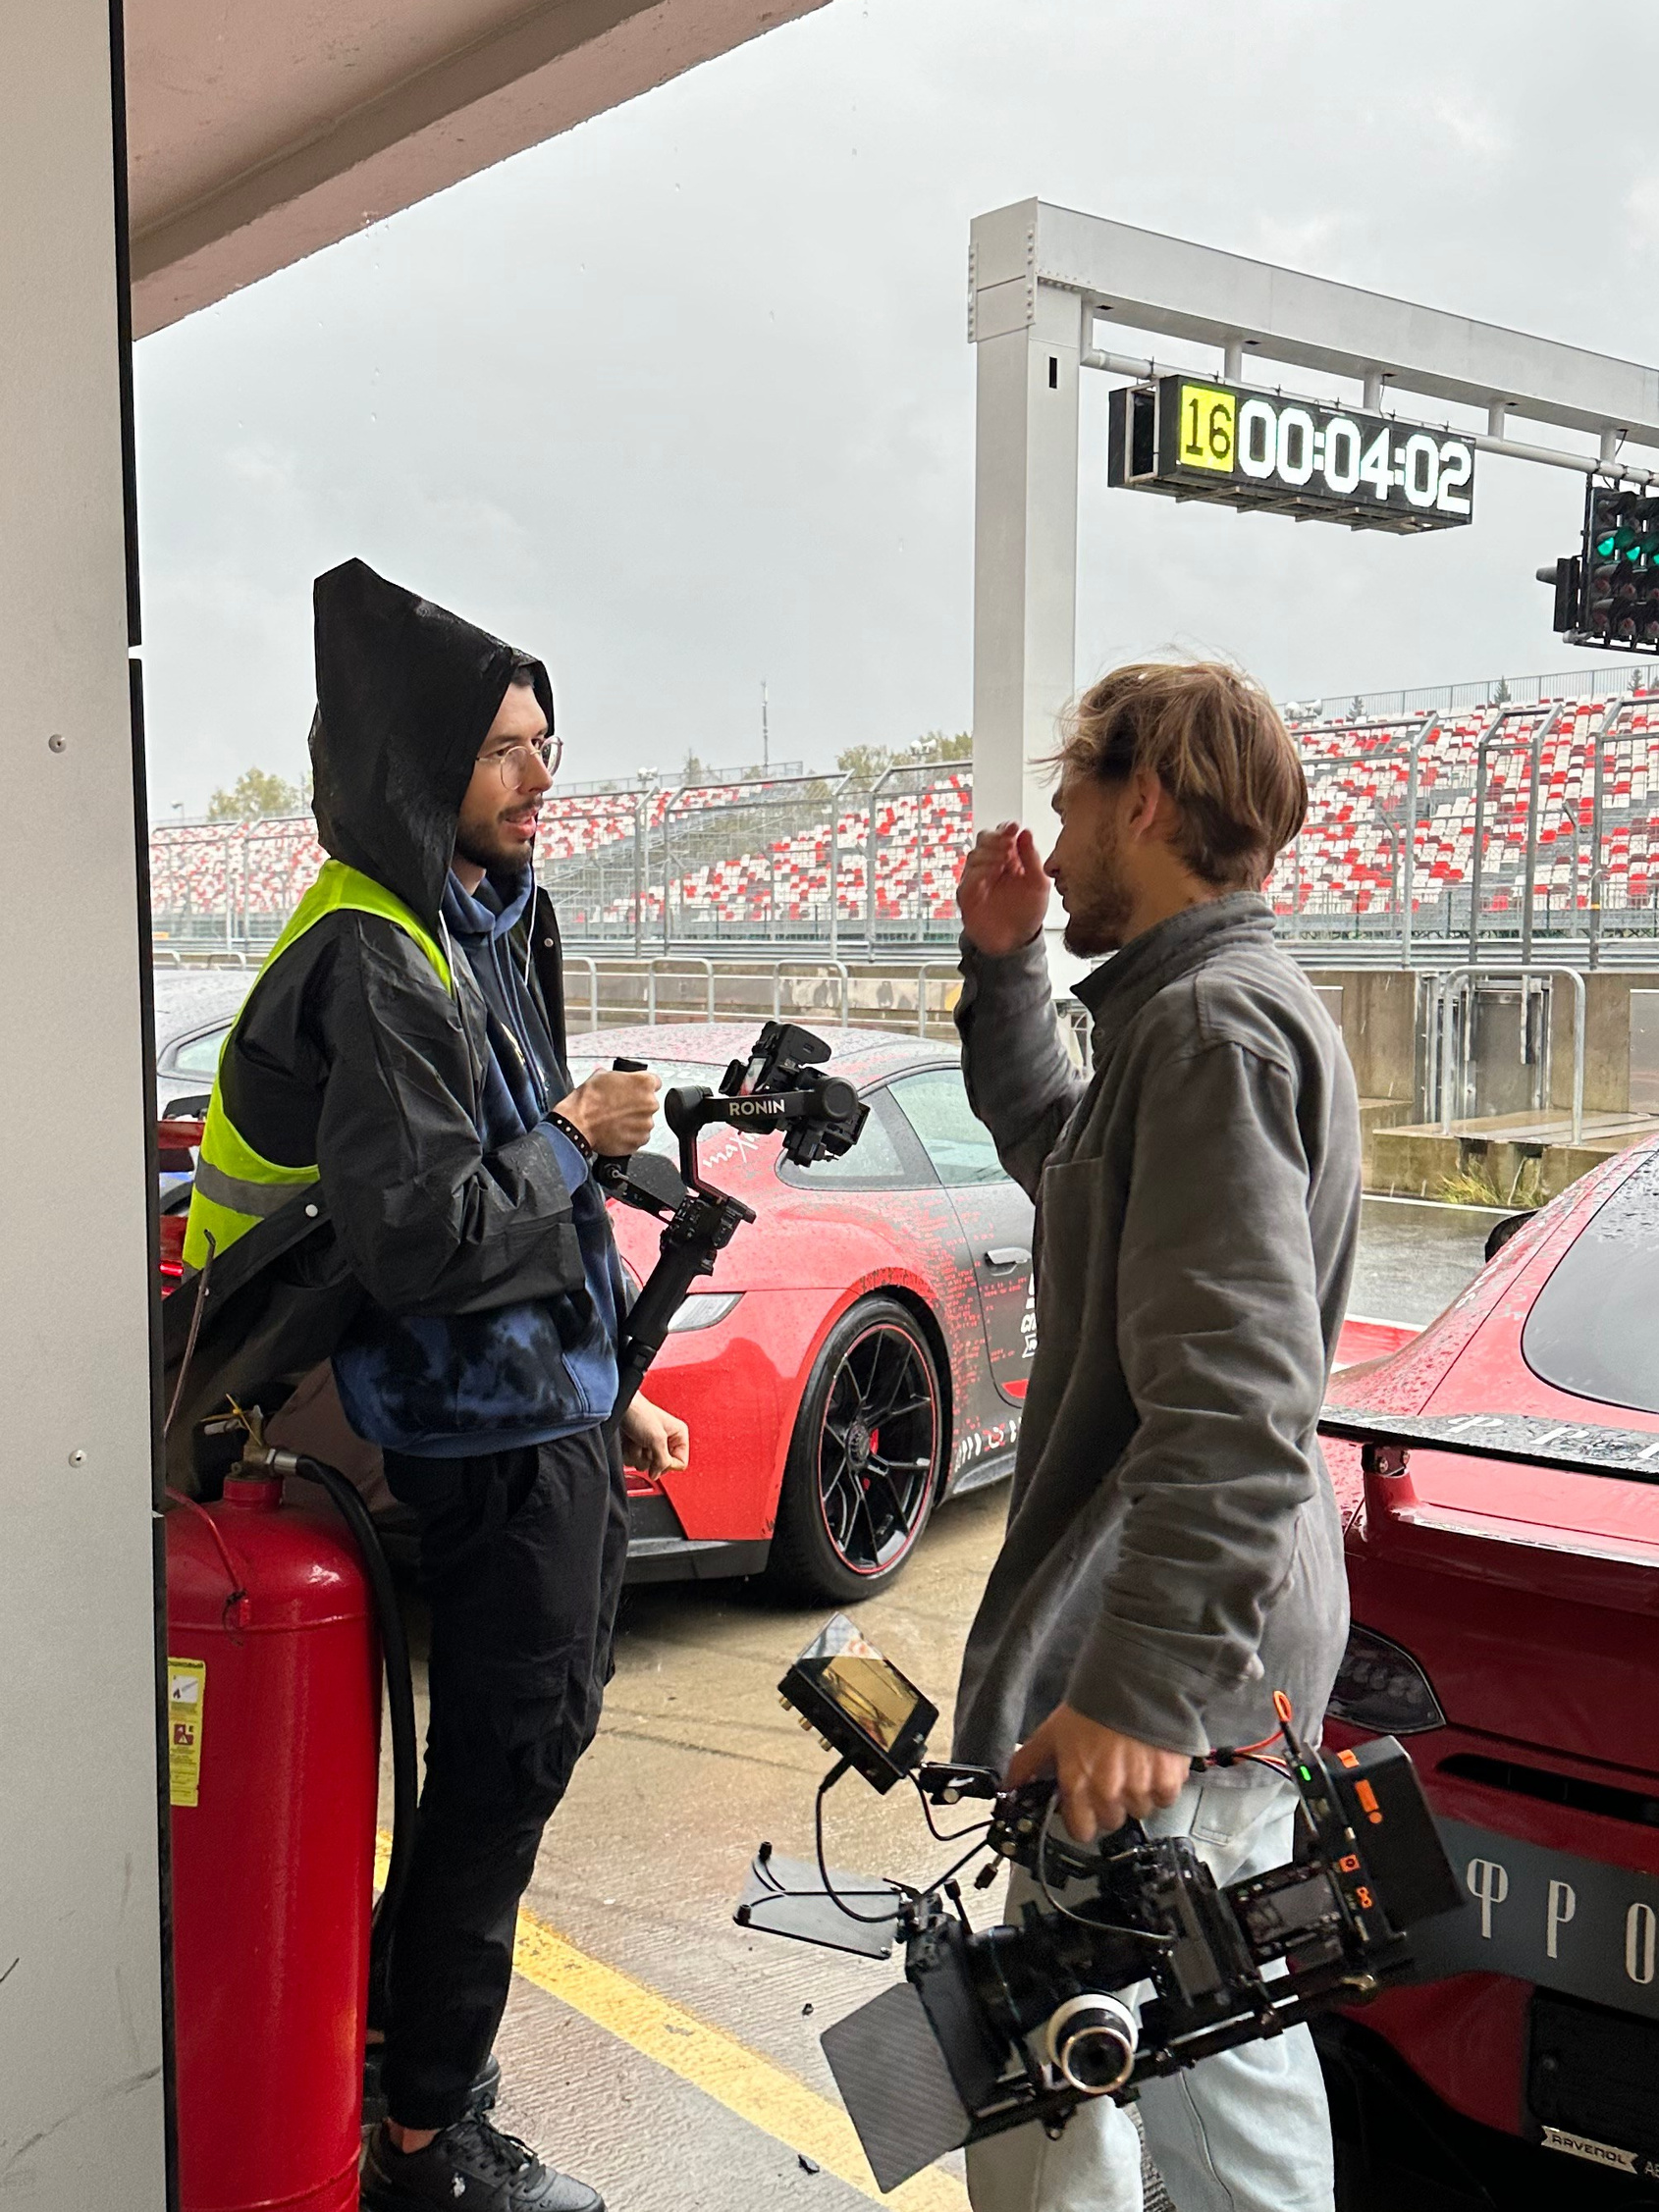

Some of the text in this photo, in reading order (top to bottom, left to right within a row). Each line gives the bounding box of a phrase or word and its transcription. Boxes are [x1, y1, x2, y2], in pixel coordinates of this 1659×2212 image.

[1185, 397, 1472, 515] 16 00:04:02
[729, 1099, 785, 1116] RONIN
[1551, 2133, 1628, 2165] RAVENOL
